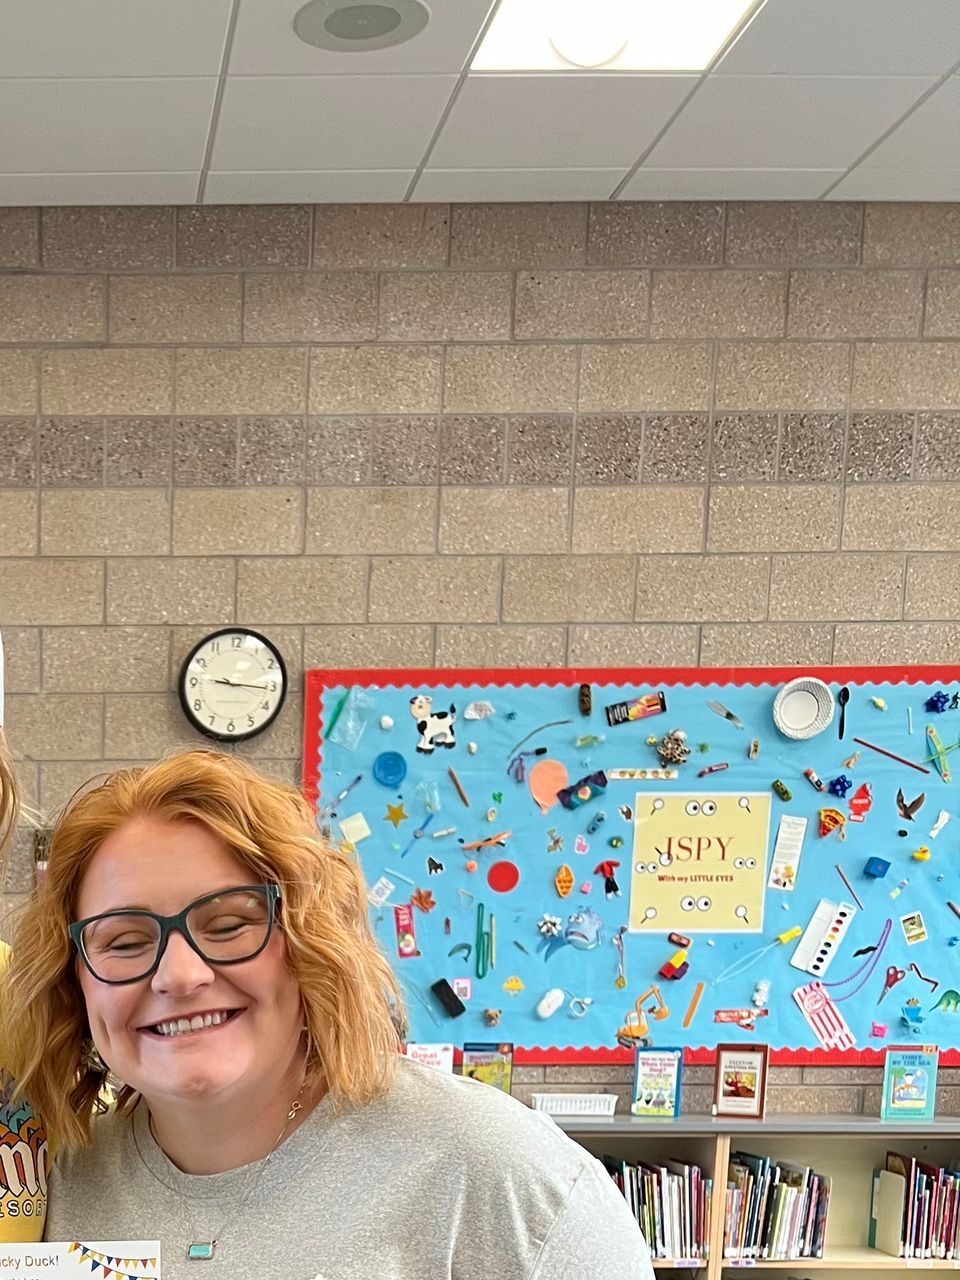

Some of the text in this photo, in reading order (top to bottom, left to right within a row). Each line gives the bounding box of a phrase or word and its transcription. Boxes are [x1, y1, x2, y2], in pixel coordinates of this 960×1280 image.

[232, 637, 242, 648] 12
[268, 659, 275, 669] 2
[189, 677, 198, 687] 9
[269, 681, 277, 692] 3
[193, 699, 202, 711] 8
[261, 700, 269, 711] 4
[209, 715, 215, 726] 7
[248, 716, 255, 727] 5
[227, 721, 235, 732] 6
[689, 874, 714, 882] LITTLE
[715, 874, 734, 882] EYES
[25, 1255, 59, 1267] Duck!
